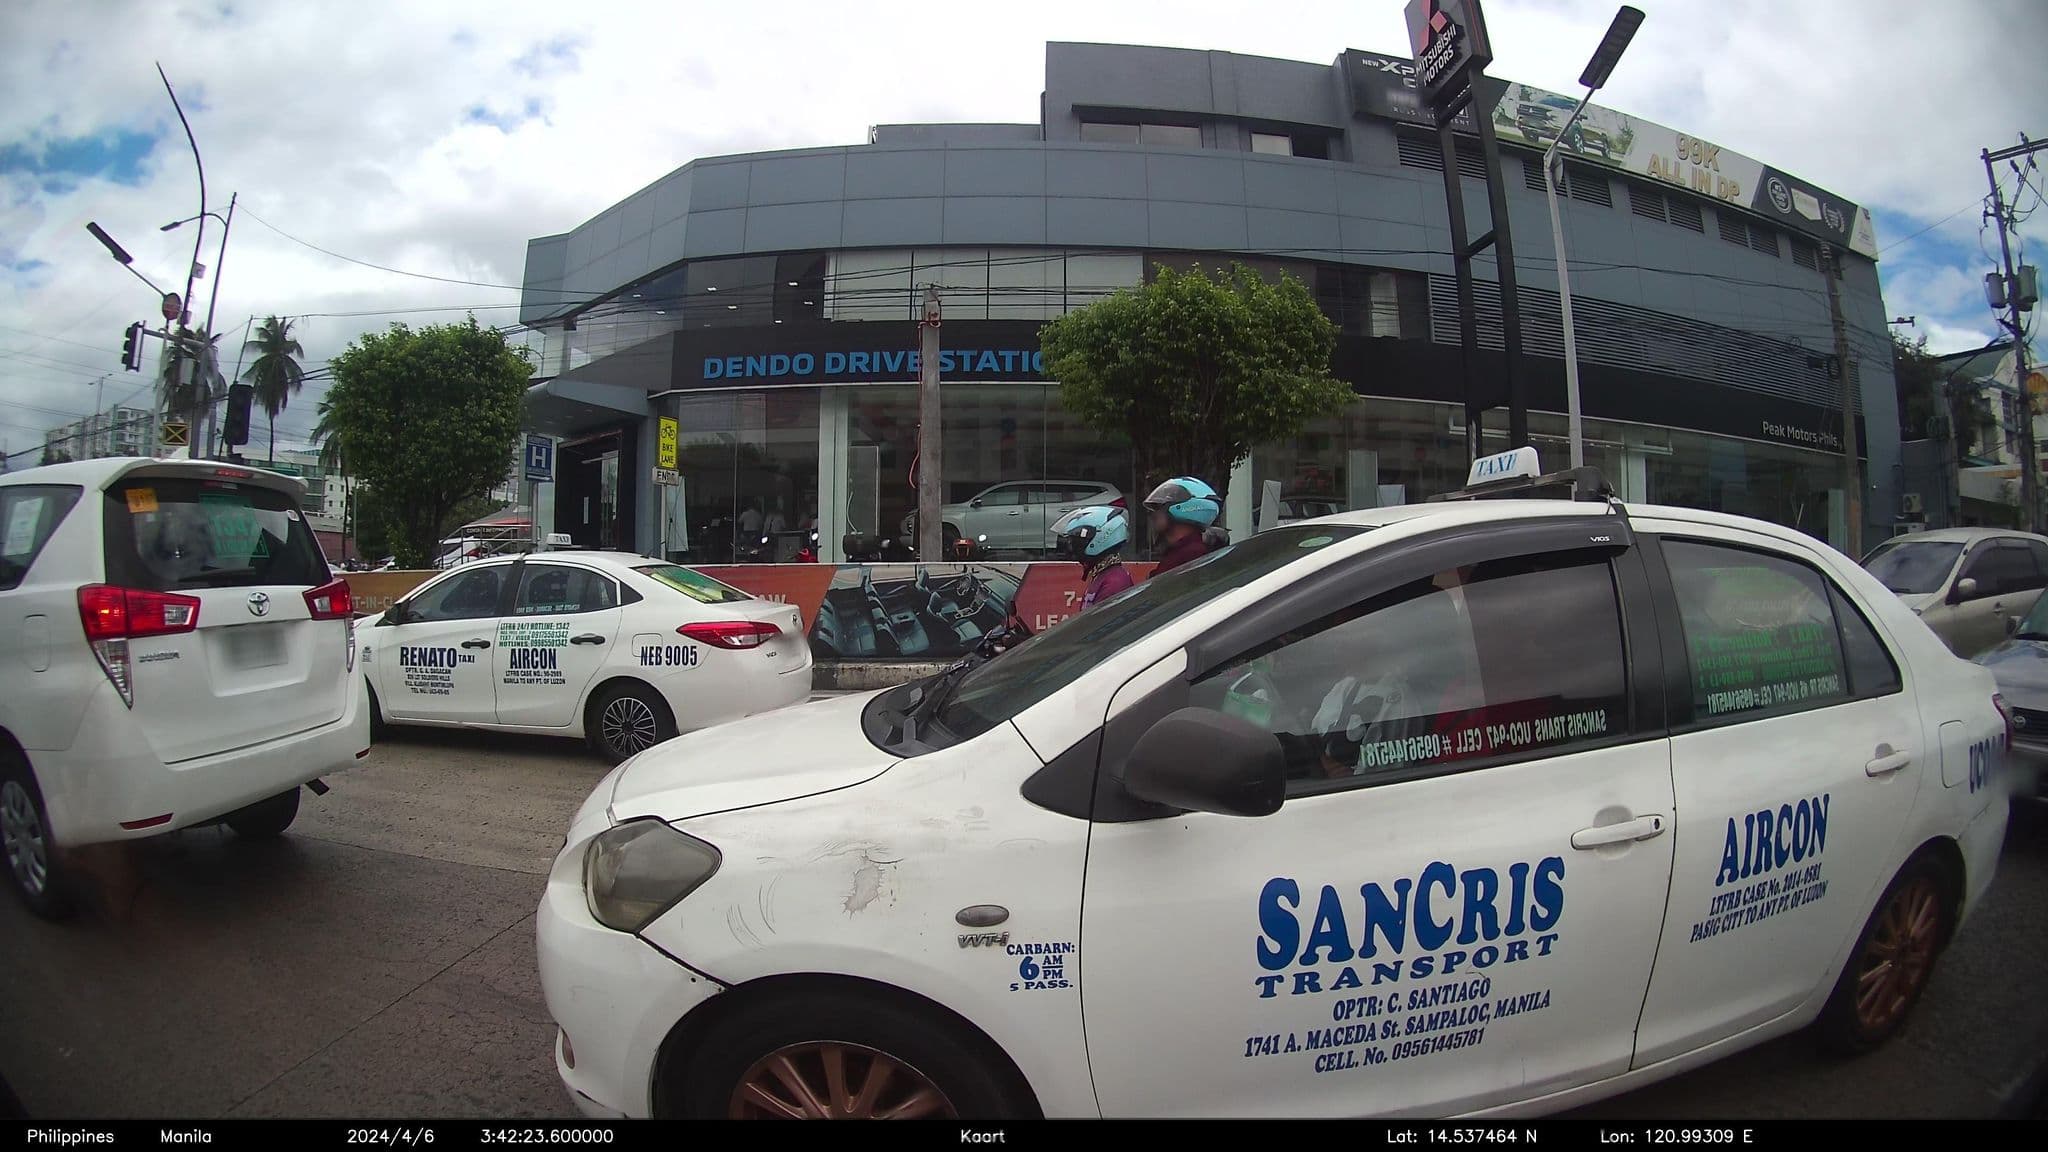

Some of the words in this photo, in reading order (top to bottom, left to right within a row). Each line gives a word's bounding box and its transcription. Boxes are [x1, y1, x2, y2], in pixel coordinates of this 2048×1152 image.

[1415, 24, 1456, 77] MITSUBISHI
[1362, 59, 1379, 67] NEW
[1423, 45, 1454, 87] MOTORS
[1676, 133, 1721, 172] 99K
[1647, 153, 1686, 185] ALL
[1691, 168, 1711, 195] IN
[1717, 175, 1740, 202] DP
[703, 353, 815, 380] DENDO
[824, 351, 923, 374] DRIVE
[938, 350, 1046, 373] STATI
[1762, 421, 1786, 437] Peak
[1787, 426, 1818, 442] Motors
[531, 446, 546, 468] H
[662, 455, 674, 464] LANE
[1476, 453, 1518, 477] TAXI
[554, 535, 570, 543] TAXI
[517, 622, 530, 630] 24/7
[400, 647, 457, 668] RENATO
[458, 654, 475, 663] TAXI
[510, 648, 557, 669] AIRCON
[640, 646, 662, 666] NEB
[665, 645, 698, 666] 9005
[1715, 793, 1830, 887] AIRCON
[1709, 889, 1742, 916] LTFRB
[1743, 880, 1768, 906] CASE
[1256, 856, 1565, 971] SANCRIS
[1690, 917, 1721, 943] PASIG
[1721, 908, 1746, 934] CITY
[1744, 905, 1758, 926] TO
[1757, 898, 1779, 922] ANY
[1790, 890, 1802, 909] OF
[958, 931, 1010, 948] VVT-i
[1006, 942, 1075, 955] CARBARN:
[1019, 956, 1040, 980] 6
[1042, 955, 1063, 965] AM
[1255, 933, 1559, 998] TRANSPORT
[1009, 983, 1019, 991] 5
[1024, 980, 1073, 990] PASS.
[1043, 969, 1063, 980] PM
[1333, 996, 1383, 1021] OPTR:
[1387, 993, 1402, 1013] C.
[1407, 977, 1491, 1011] SANTIAGO
[1244, 1034, 1281, 1058] 1741
[1284, 1033, 1301, 1053] A.
[1305, 1022, 1377, 1050] MACEDA
[1380, 1019, 1400, 1040] St.
[1405, 1003, 1490, 1036] SAMPALOC,
[1494, 989, 1551, 1019] MANILA
[1315, 1050, 1359, 1073] CELL.
[1363, 1047, 1388, 1066] No.
[1392, 1027, 1485, 1060] 09561445781
